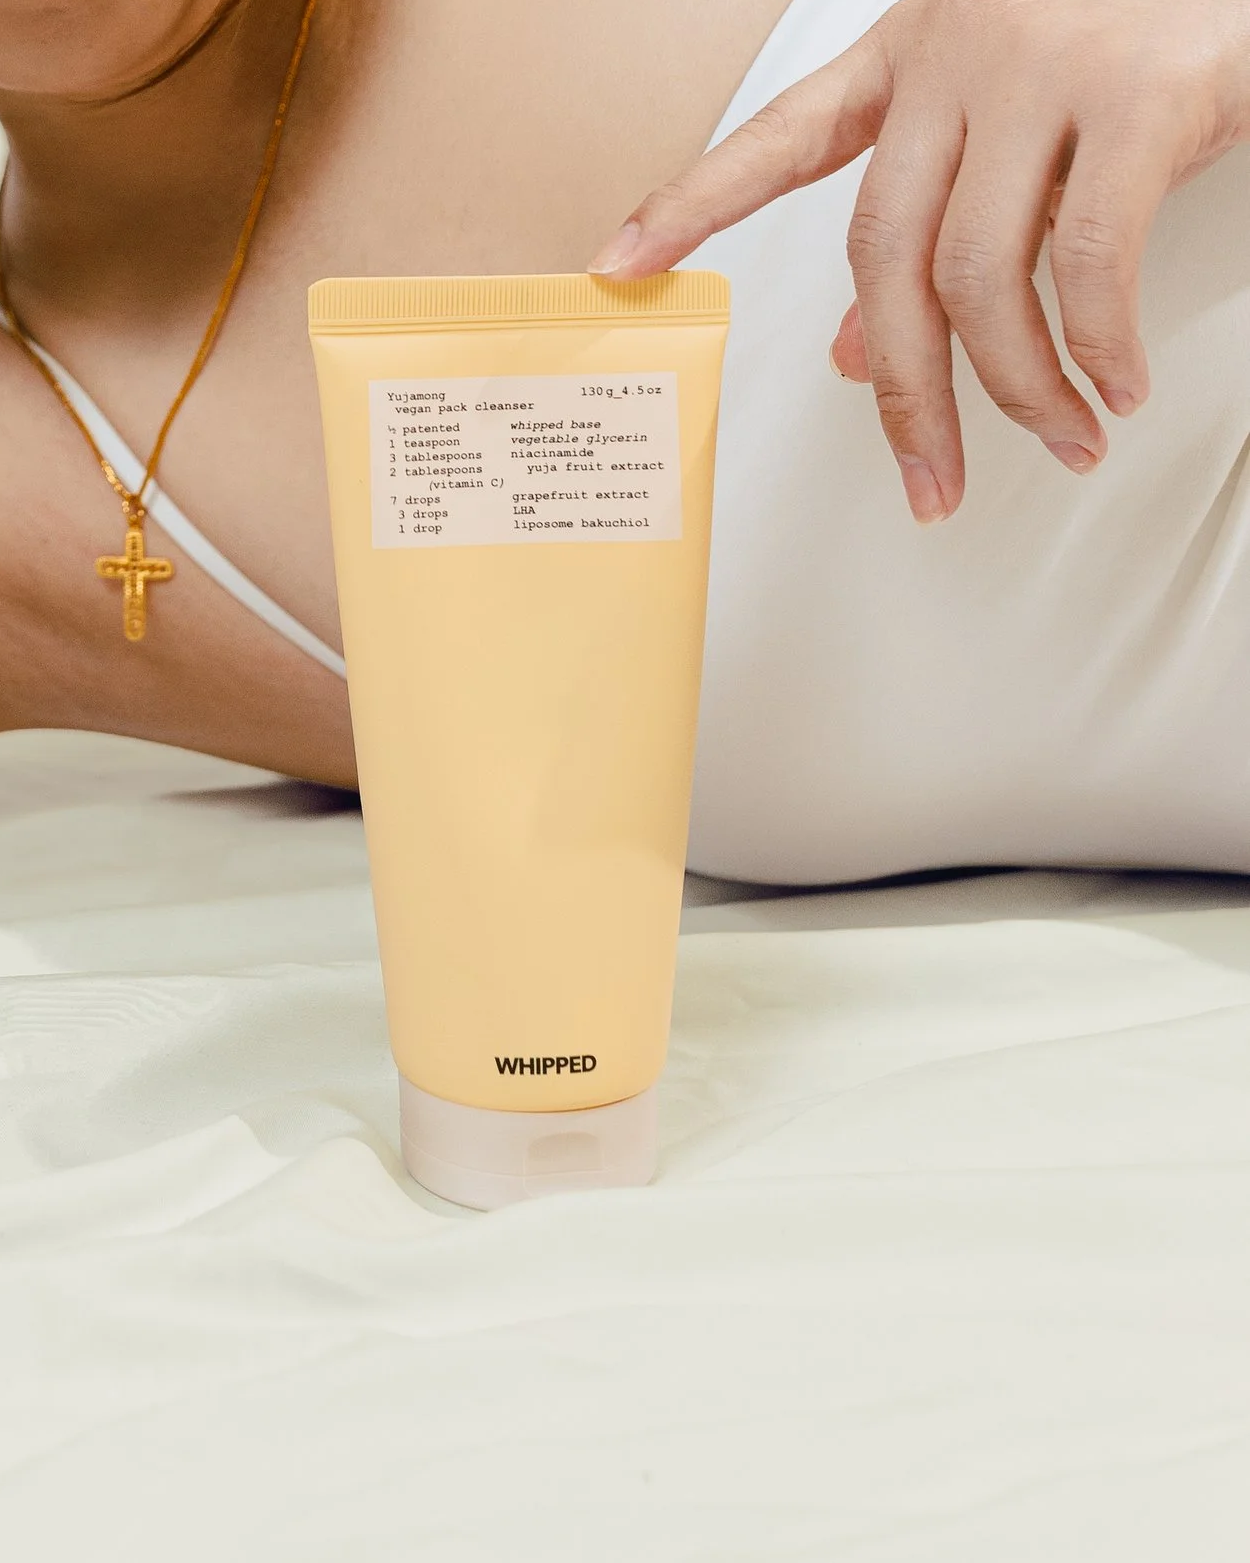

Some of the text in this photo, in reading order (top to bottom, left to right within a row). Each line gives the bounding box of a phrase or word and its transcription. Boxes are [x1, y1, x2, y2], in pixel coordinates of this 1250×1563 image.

[388, 392, 445, 403] Yujamong
[395, 402, 534, 416] vegan pack cleanser
[403, 423, 460, 436] patented
[511, 420, 601, 432] whipped base
[390, 439, 460, 449] 1 teaspoon
[511, 433, 647, 445] vegetable glycerin
[390, 452, 482, 463] 3 tablespoons
[511, 448, 594, 458] niacinamide
[390, 466, 482, 477] 2 tablespoons
[527, 462, 664, 474] yuja fruit extract
[429, 478, 503, 491] (vitamin C)
[390, 496, 440, 506] 7 drops
[512, 490, 649, 503] grapefruit extract
[399, 510, 448, 520] 3 drops
[513, 506, 536, 514] LHA
[399, 524, 442, 534] 1 drop
[514, 518, 649, 531] liposome bakuchiol
[495, 1055, 596, 1075] WHIPPED
